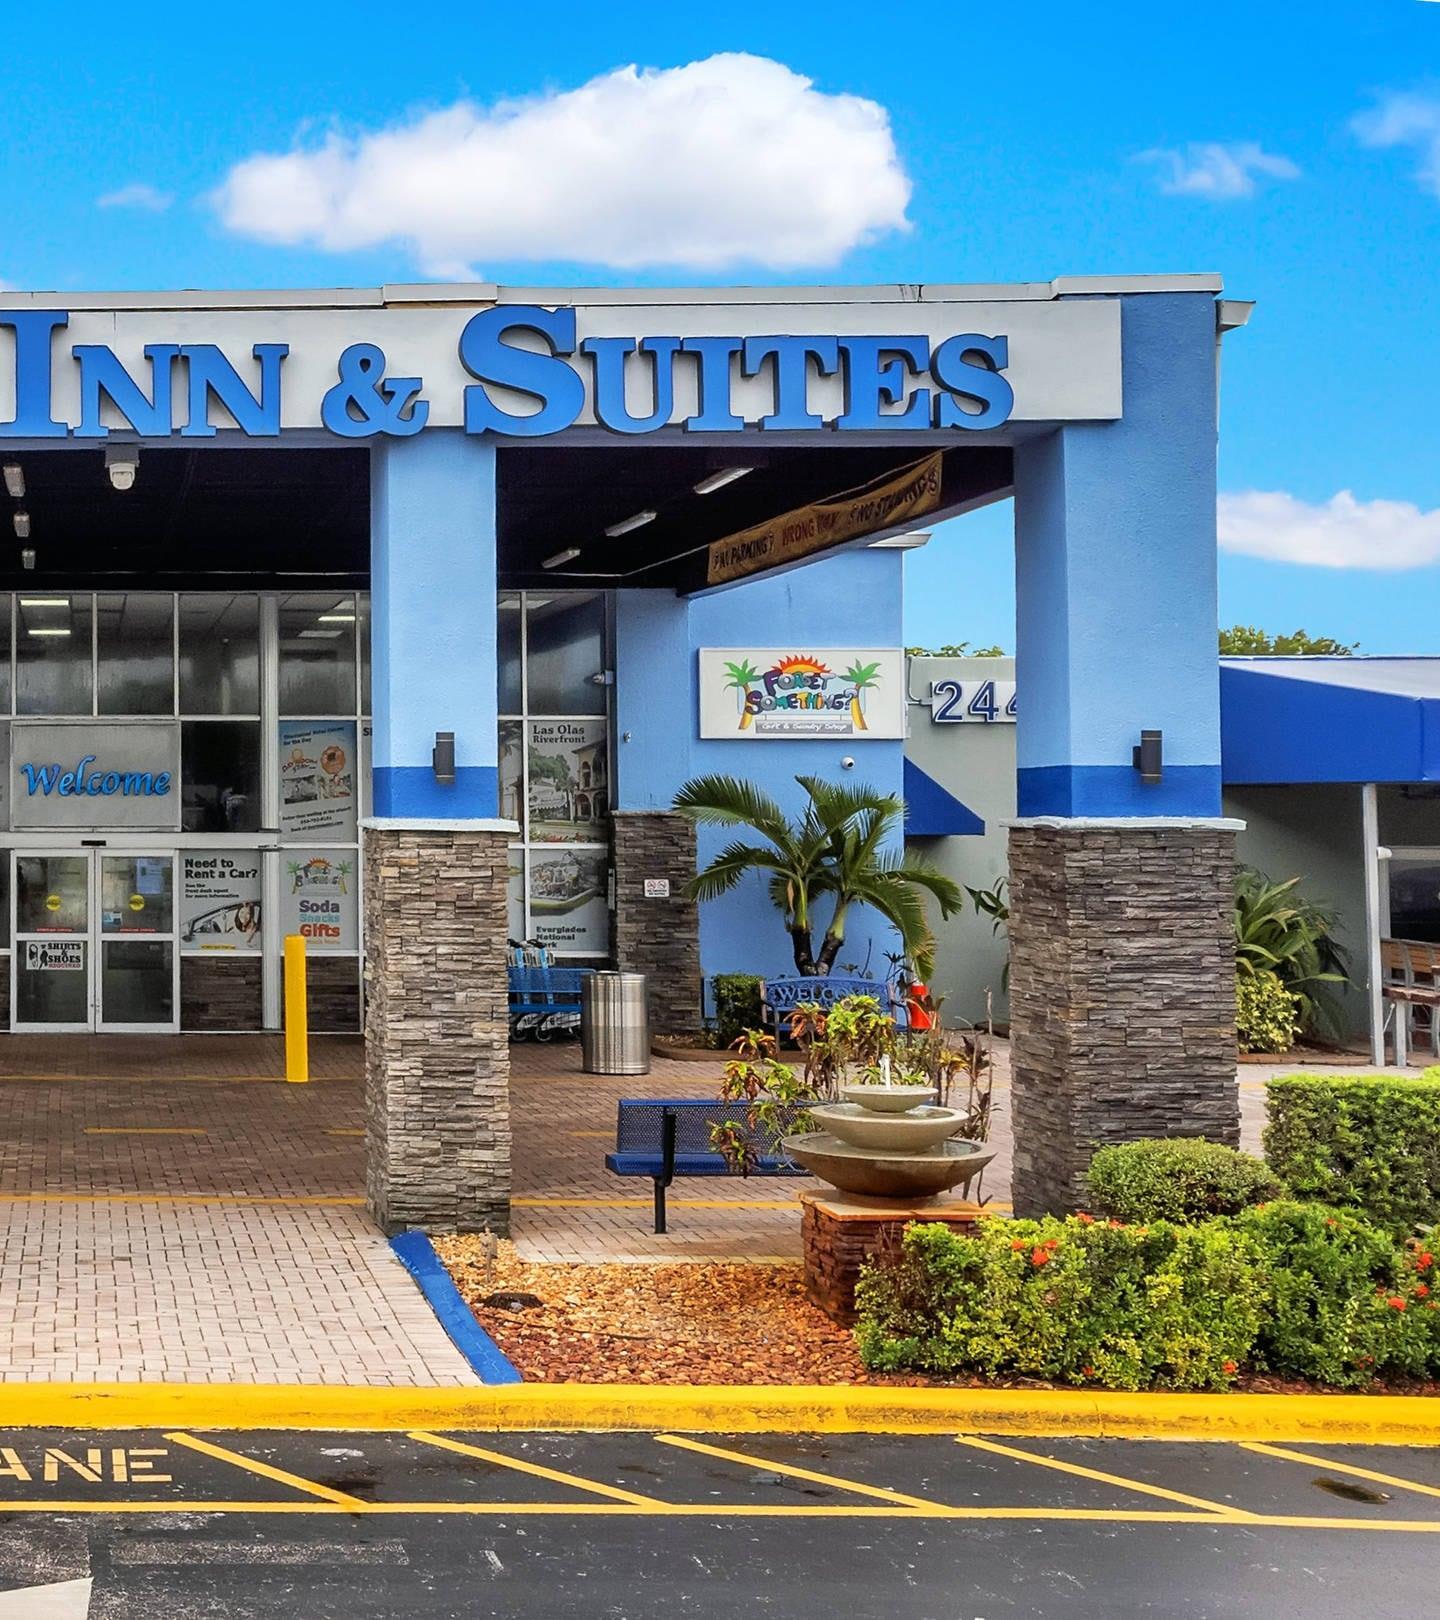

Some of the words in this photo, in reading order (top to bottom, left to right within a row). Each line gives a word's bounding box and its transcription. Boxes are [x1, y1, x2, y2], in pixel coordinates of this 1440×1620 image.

[322, 342, 429, 438] &
[458, 305, 1013, 437] SUITES
[762, 668, 837, 697] FORGET
[745, 688, 858, 715] SOMETHING?
[533, 725, 554, 735] Las
[557, 725, 585, 735] Olas
[825, 723, 847, 731] Shop
[533, 735, 586, 744] Riverfront
[20, 754, 171, 797] Welcome
[185, 858, 217, 868] Need
[221, 858, 234, 868] to
[185, 869, 216, 879] Rent
[218, 870, 226, 878] a
[229, 868, 258, 878] Car?
[299, 900, 340, 913] Soda
[299, 913, 341, 923] Snacks
[299, 924, 341, 937] Gifts
[536, 926, 587, 934] Everglades
[48, 955, 81, 963] SHOES
